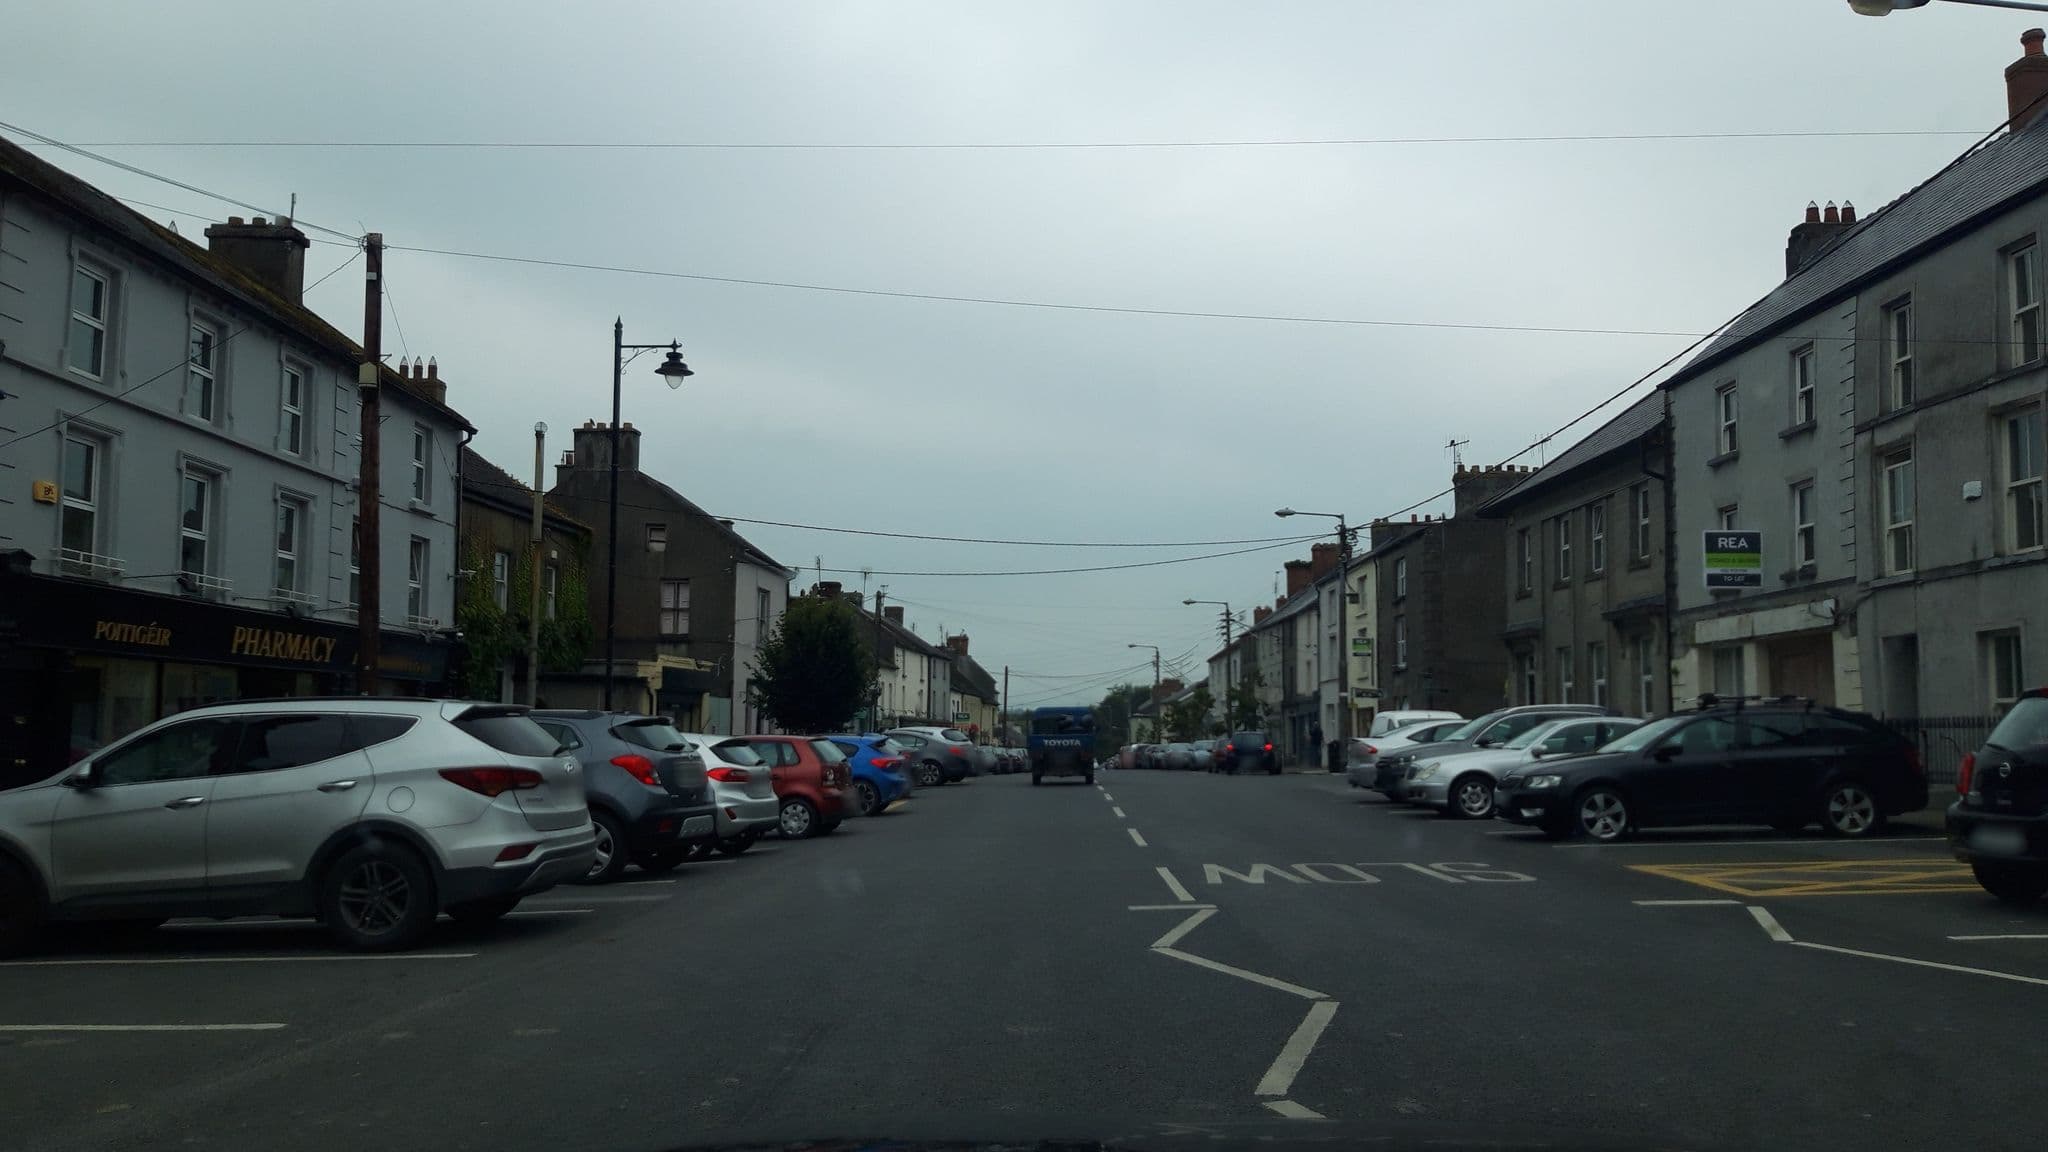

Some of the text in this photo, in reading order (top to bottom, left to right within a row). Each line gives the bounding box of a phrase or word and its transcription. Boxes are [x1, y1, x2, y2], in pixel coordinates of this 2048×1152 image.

[1718, 536, 1749, 549] REA
[94, 619, 174, 647] POITIGÉIR
[231, 625, 337, 663] PHARMACY
[1043, 738, 1081, 747] TOYOTA
[1202, 862, 1538, 884] SLOW
